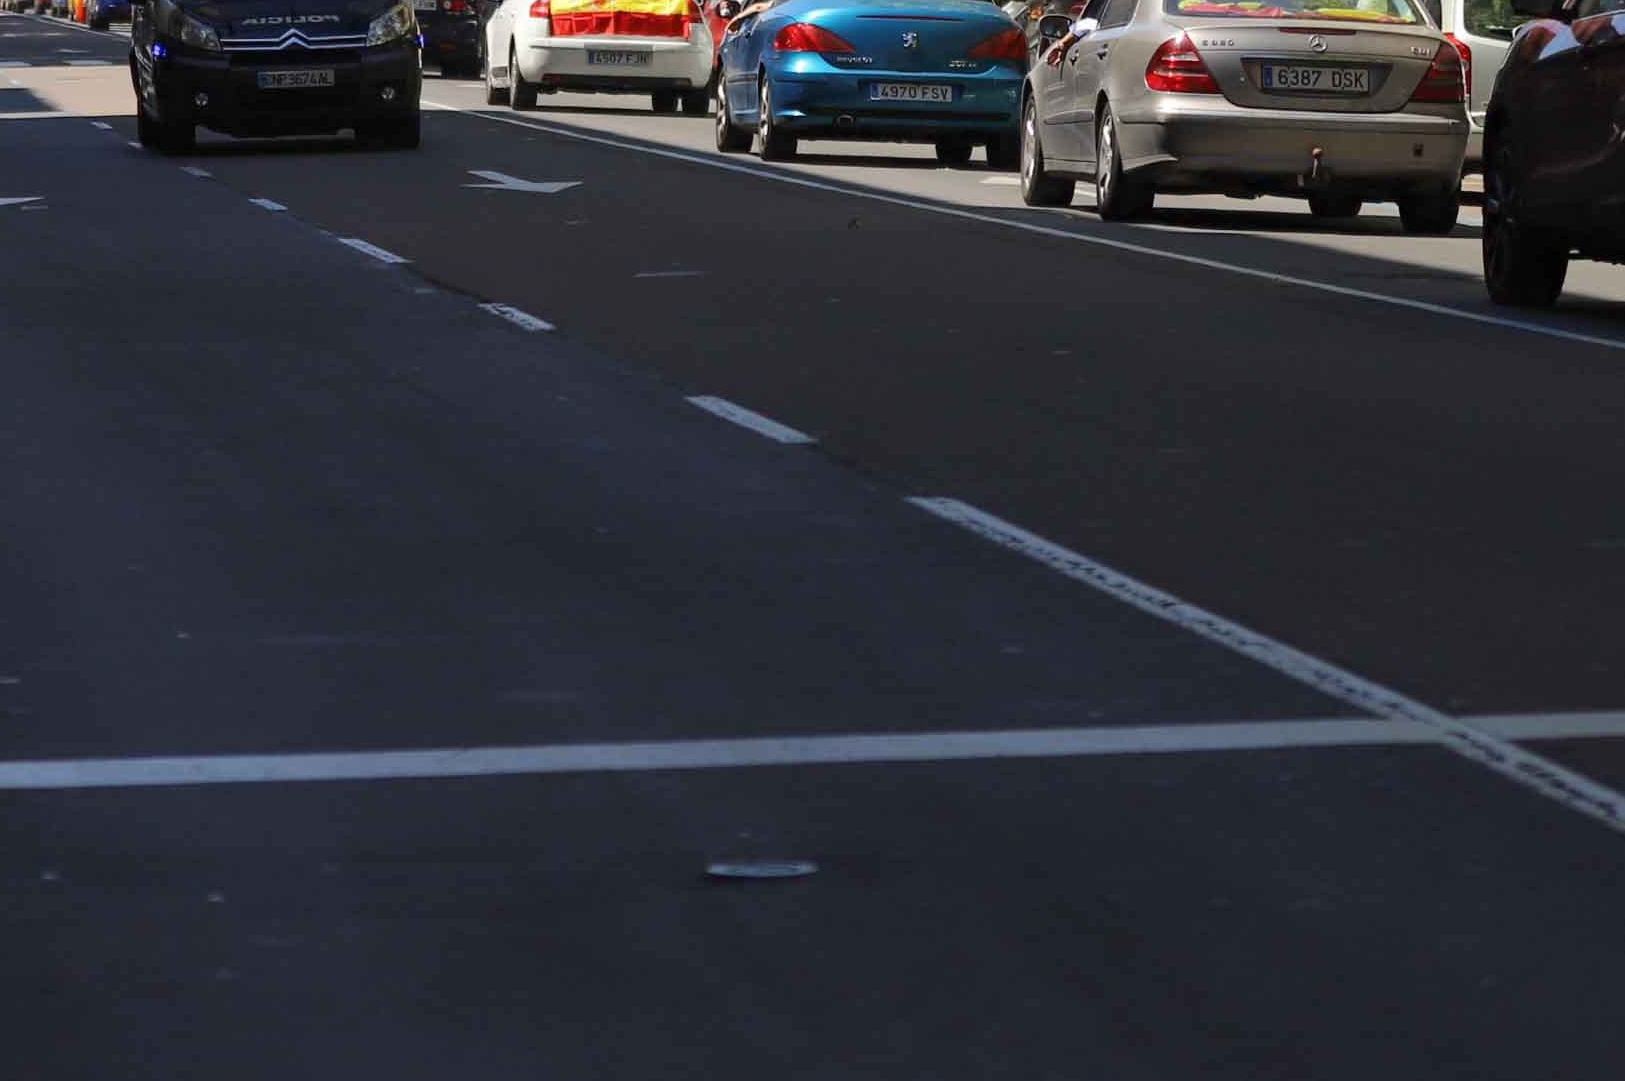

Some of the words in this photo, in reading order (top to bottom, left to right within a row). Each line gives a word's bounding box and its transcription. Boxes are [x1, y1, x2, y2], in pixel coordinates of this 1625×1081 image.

[1278, 70, 1321, 87] 6387
[1331, 71, 1364, 88] DSK
[881, 85, 917, 99] 4970
[922, 87, 948, 101] FSV
